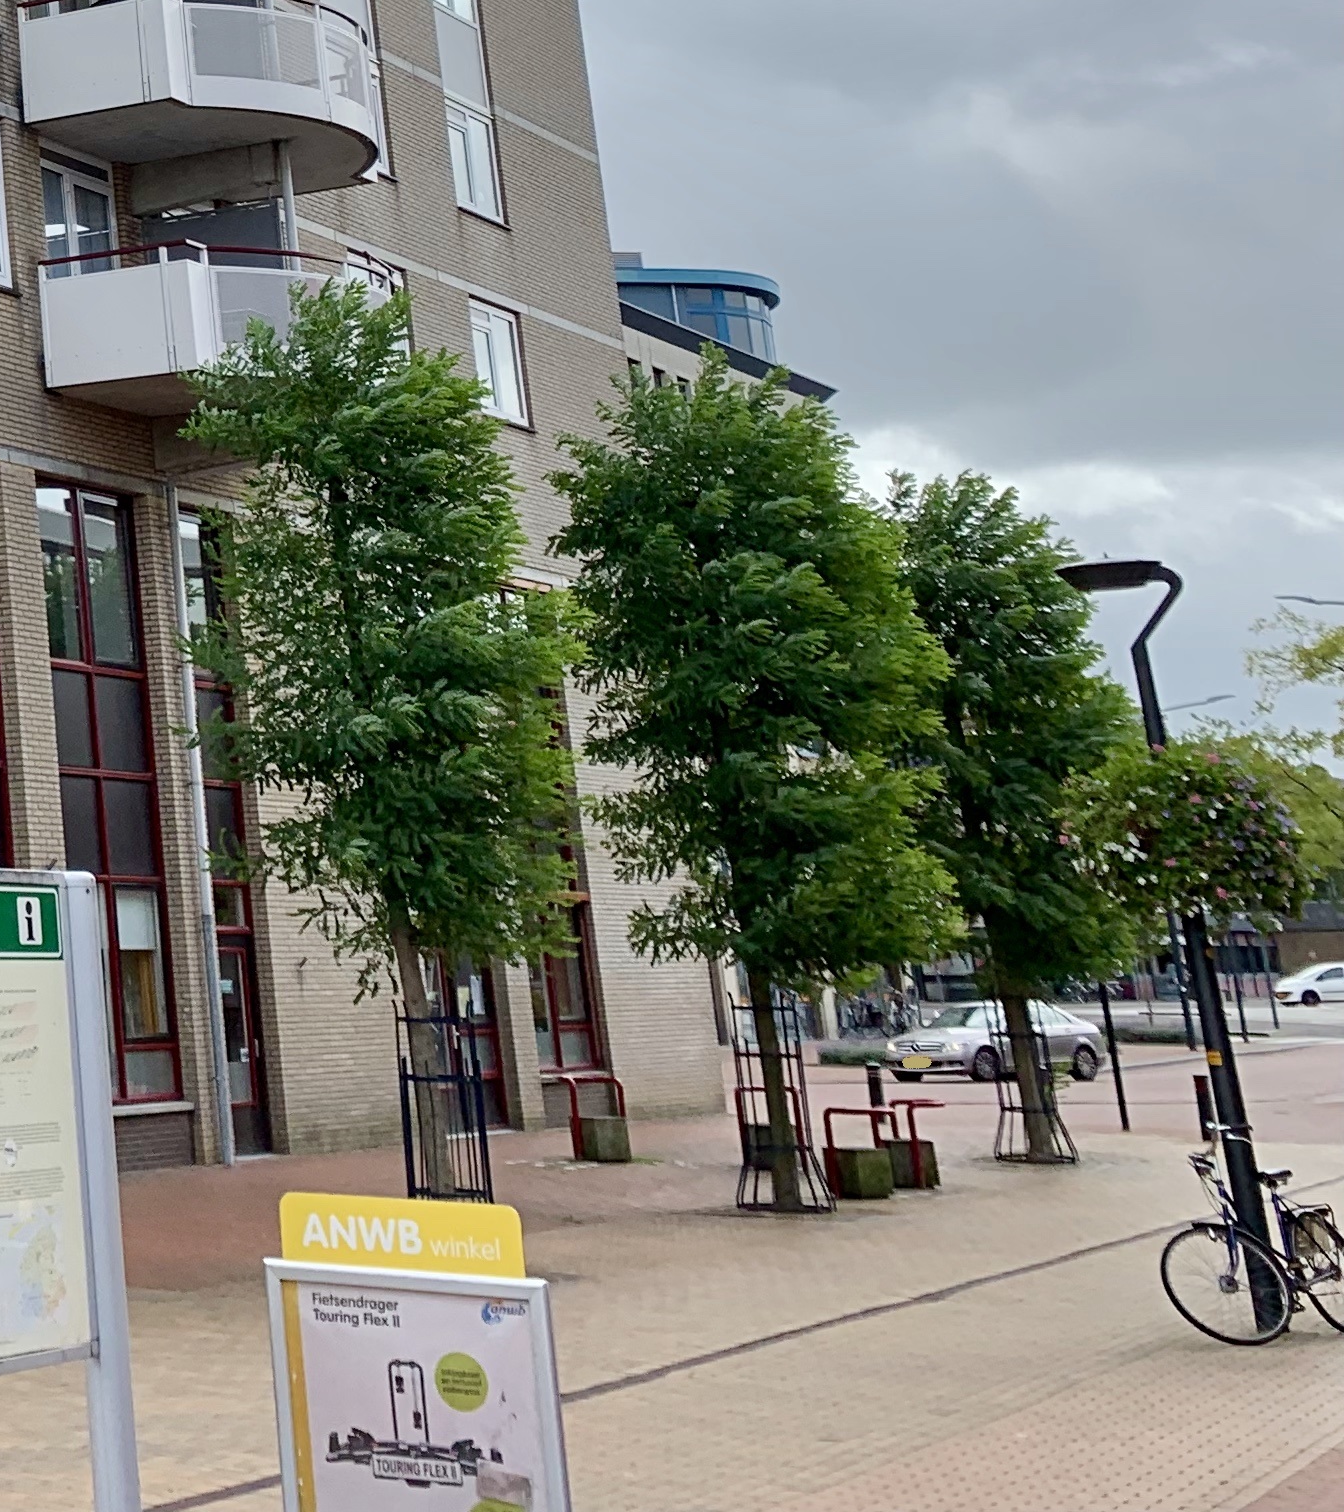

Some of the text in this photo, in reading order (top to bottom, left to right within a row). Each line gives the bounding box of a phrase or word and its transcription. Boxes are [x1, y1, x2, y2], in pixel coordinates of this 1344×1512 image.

[302, 1212, 501, 1261] ANWB winkel
[311, 1292, 399, 1313] Fietsendrager
[313, 1307, 360, 1328] Touring
[363, 1311, 388, 1326] Flex
[376, 1459, 421, 1476] TOURING
[423, 1463, 447, 1478] FLEX
